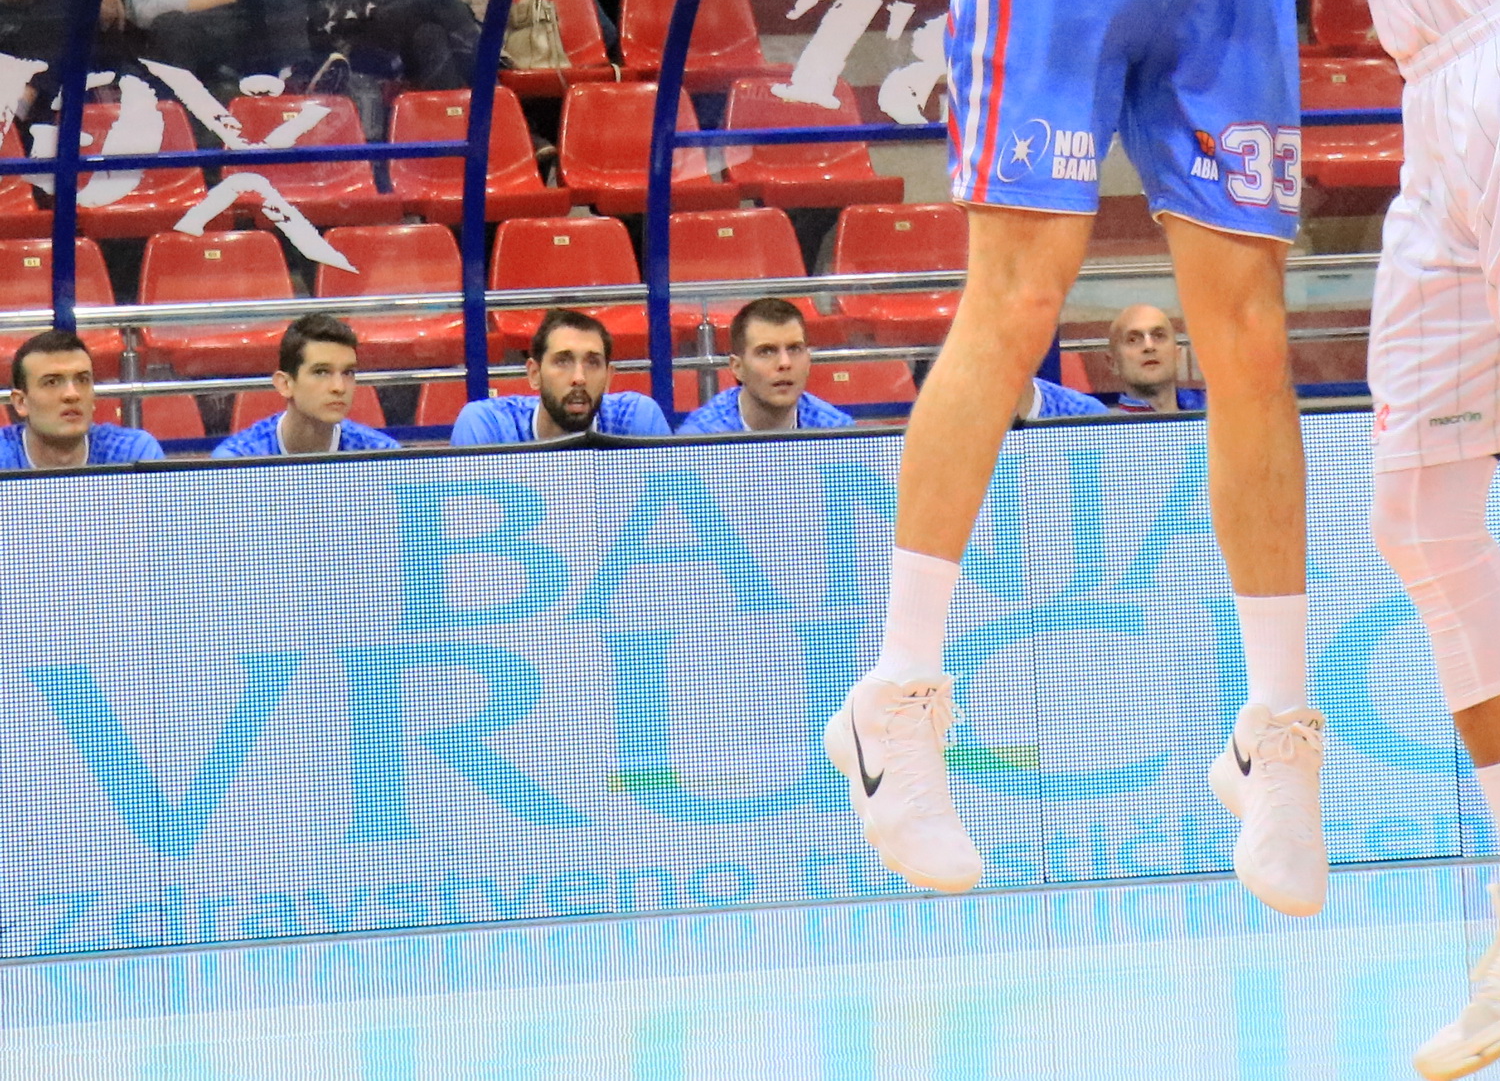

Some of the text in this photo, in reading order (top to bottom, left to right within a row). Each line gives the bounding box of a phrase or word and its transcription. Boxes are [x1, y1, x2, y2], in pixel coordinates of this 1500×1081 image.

[1191, 156, 1219, 181] ABA
[1221, 122, 1301, 214] 33
[1429, 411, 1481, 427] macron
[390, 440, 1334, 630] BANJA
